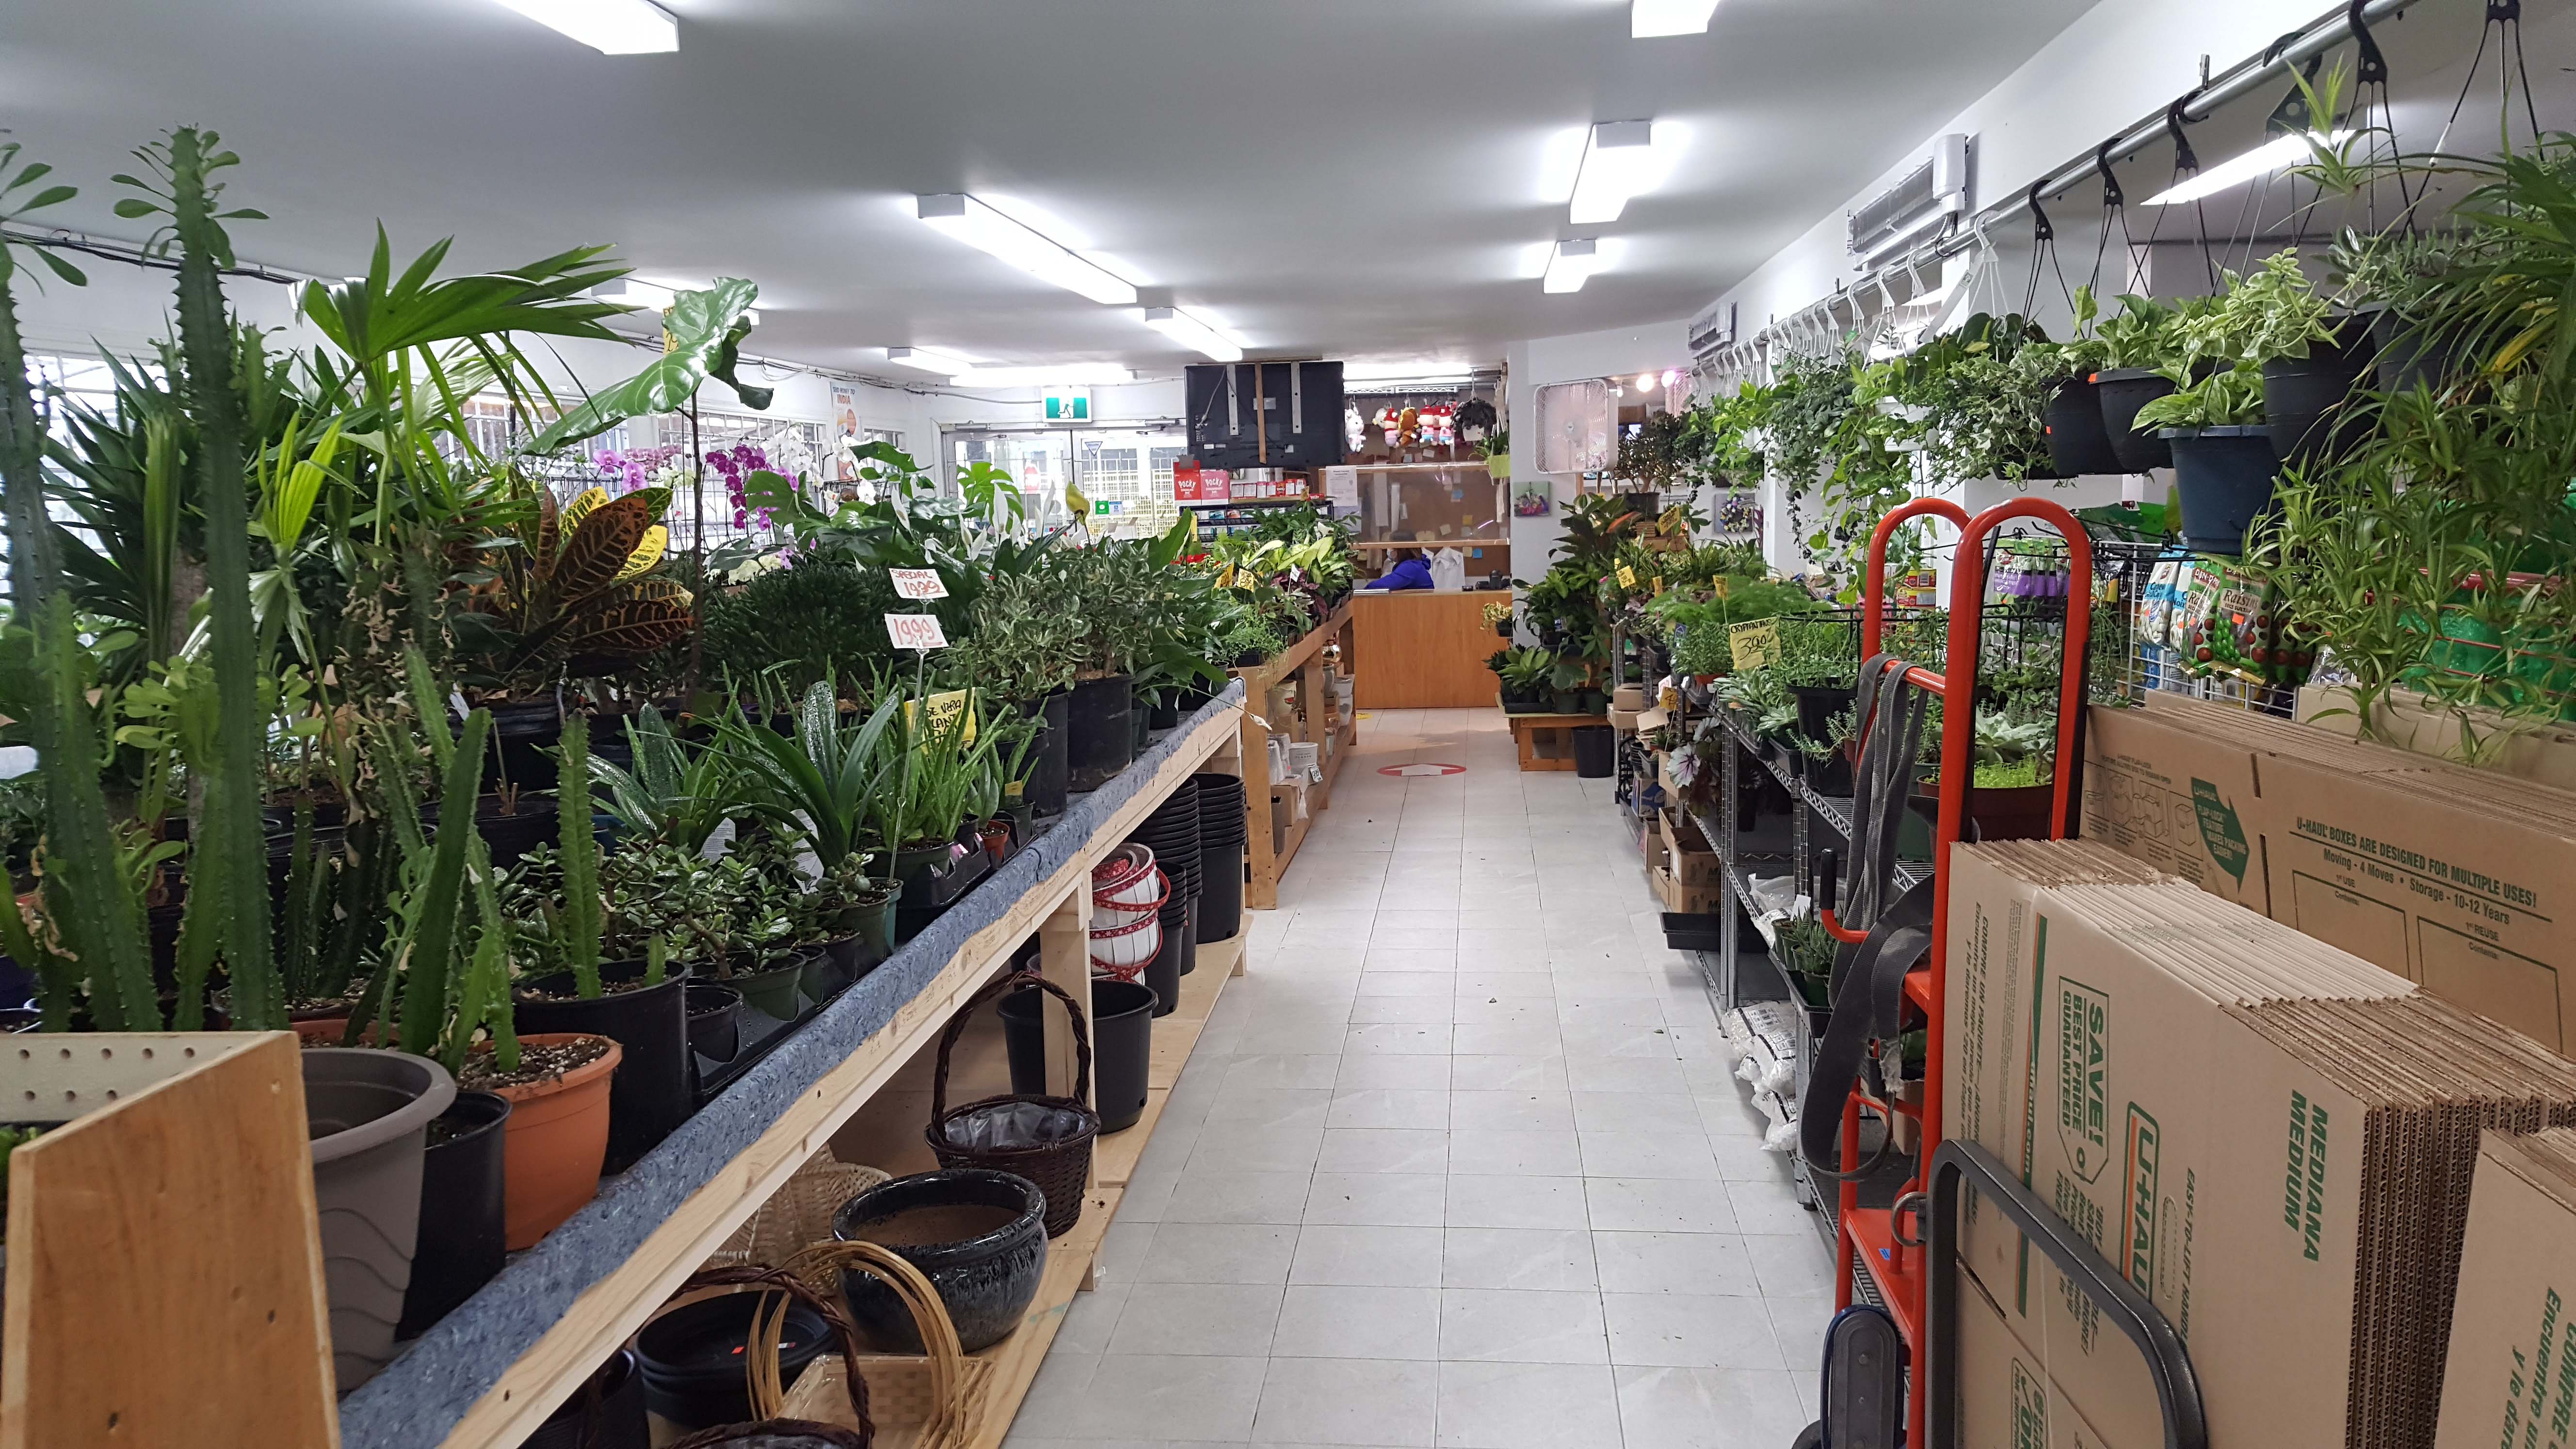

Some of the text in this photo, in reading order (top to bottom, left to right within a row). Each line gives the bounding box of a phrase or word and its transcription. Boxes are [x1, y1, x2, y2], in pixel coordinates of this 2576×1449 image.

[837, 394, 851, 404] INDIA
[1178, 479, 1196, 489] POCKY
[1205, 477, 1223, 487] POCKY
[891, 569, 933, 580] SPECIAL
[893, 618, 935, 645] 1999
[2323, 848, 2352, 871] Moving
[2360, 863, 2365, 873] 4
[2367, 863, 2394, 884] Moves
[2409, 878, 2444, 902] Storage
[2453, 893, 2480, 915] 10-12
[2483, 903, 2510, 925] Years
[2329, 826, 2357, 848] BOXES
[2359, 837, 2377, 854] ARE
[2380, 842, 2426, 870] DESIGNED
[2429, 858, 2447, 878] FOR
[2450, 865, 2500, 896] MULTIPLE
[2503, 883, 2537, 909] USES!
[2343, 876, 2355, 888] USE
[1980, 916, 1988, 980] COMPRE
[2474, 924, 2499, 942] REUSE
[1973, 974, 1978, 995] un
[1980, 981, 1986, 1004] UN
[2062, 990, 2072, 1127] GUARANTEED
[2072, 994, 2083, 1134] BEST PRICE
[2089, 1002, 2104, 1148] SAVE!
[2285, 1089, 2307, 1233] MEDIUM
[2303, 1103, 2328, 1262] MEDIANA
[2133, 1126, 2154, 1292] U-HAU
[2180, 1167, 2195, 1342] EASY-TO-LIFT HANDL
[2512, 1345, 2526, 1371] y
[2530, 1287, 2561, 1419] Encuentre
[2510, 1369, 2525, 1399] le
